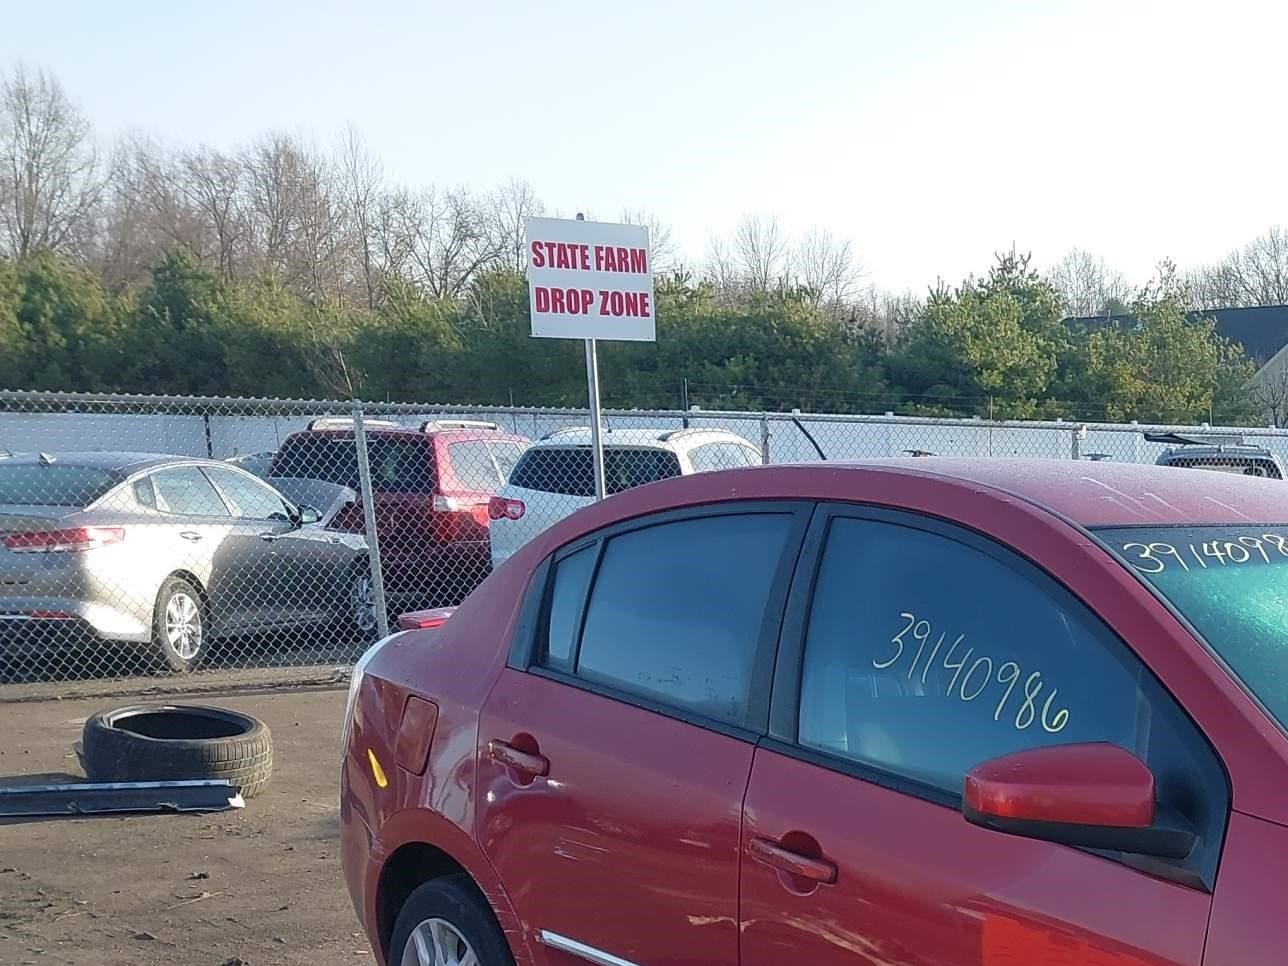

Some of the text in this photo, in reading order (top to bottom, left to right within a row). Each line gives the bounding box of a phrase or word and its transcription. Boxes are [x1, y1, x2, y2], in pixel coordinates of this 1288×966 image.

[531, 240, 648, 274] STATE FARM
[535, 287, 650, 317] DROP ZONE
[872, 612, 1069, 732] 39140986
